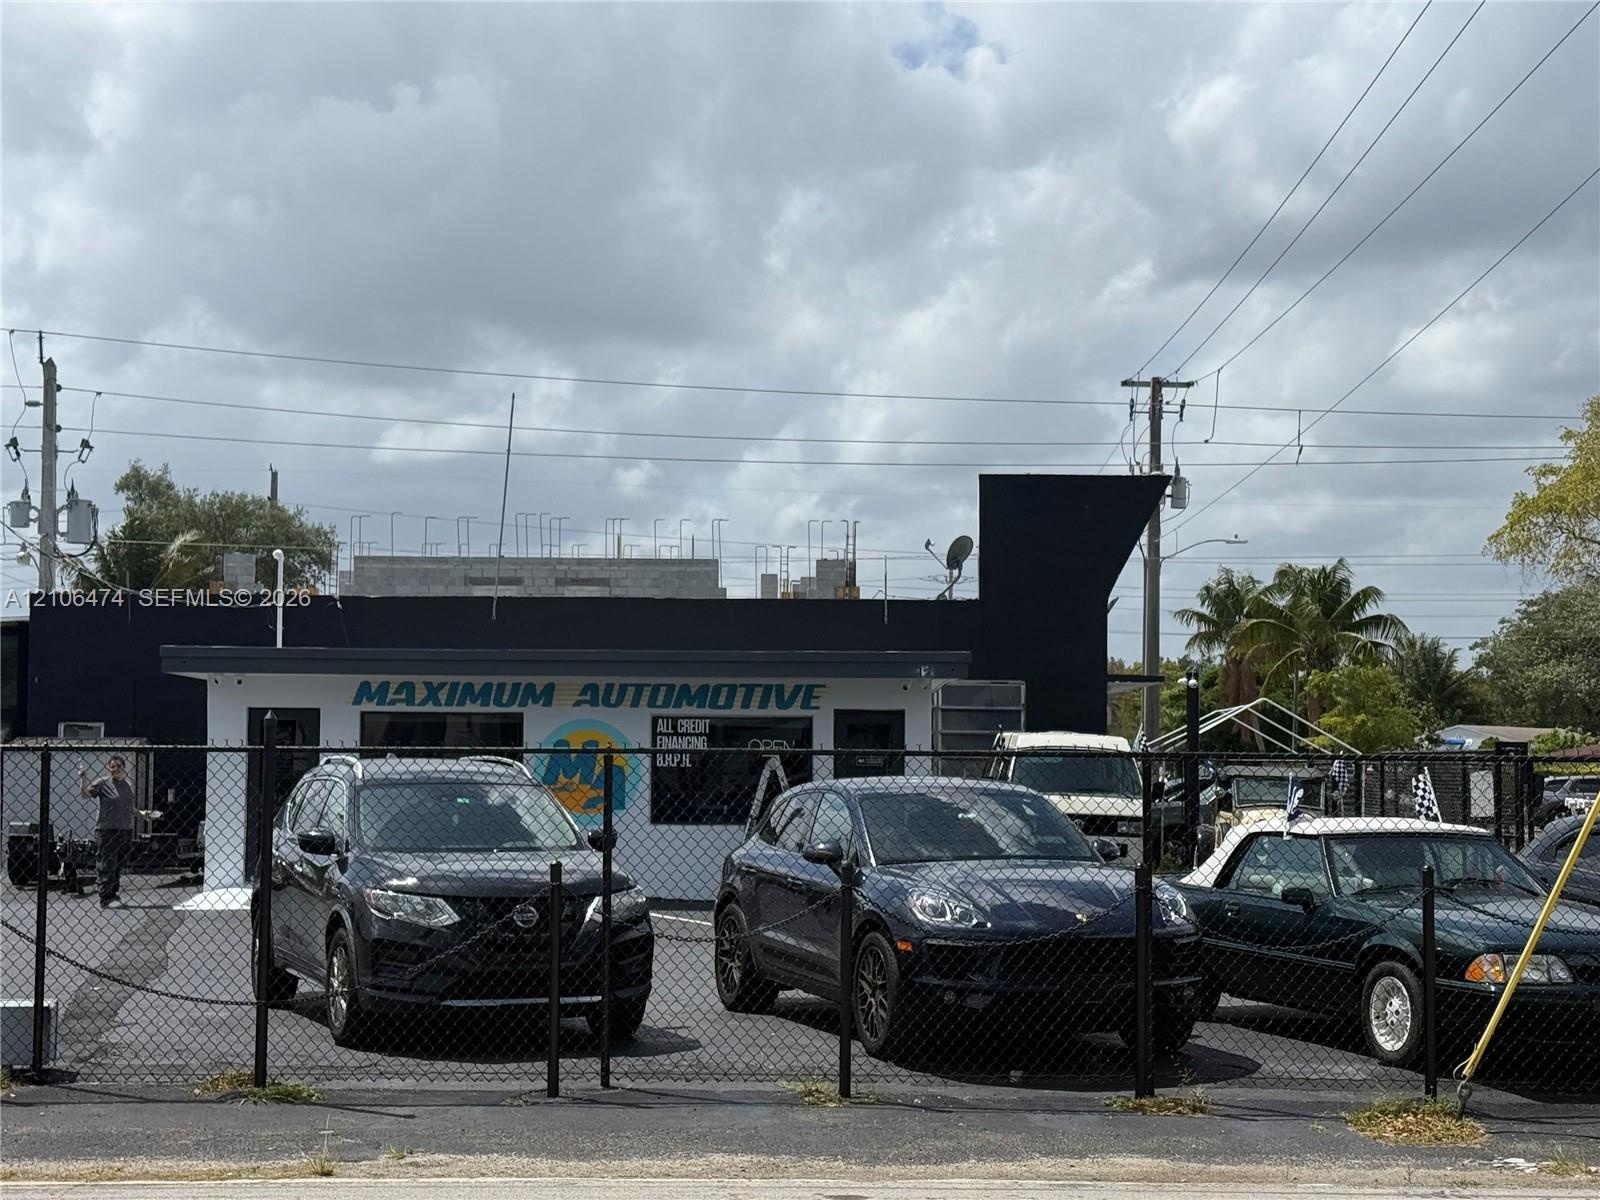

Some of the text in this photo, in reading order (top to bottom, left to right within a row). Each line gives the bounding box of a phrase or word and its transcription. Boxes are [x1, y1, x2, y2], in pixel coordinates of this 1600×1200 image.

[351, 680, 826, 710] MAXIMUM AUTOMOTIVE
[656, 718, 710, 734] ALL CREDIT
[656, 735, 708, 750] FINANCING
